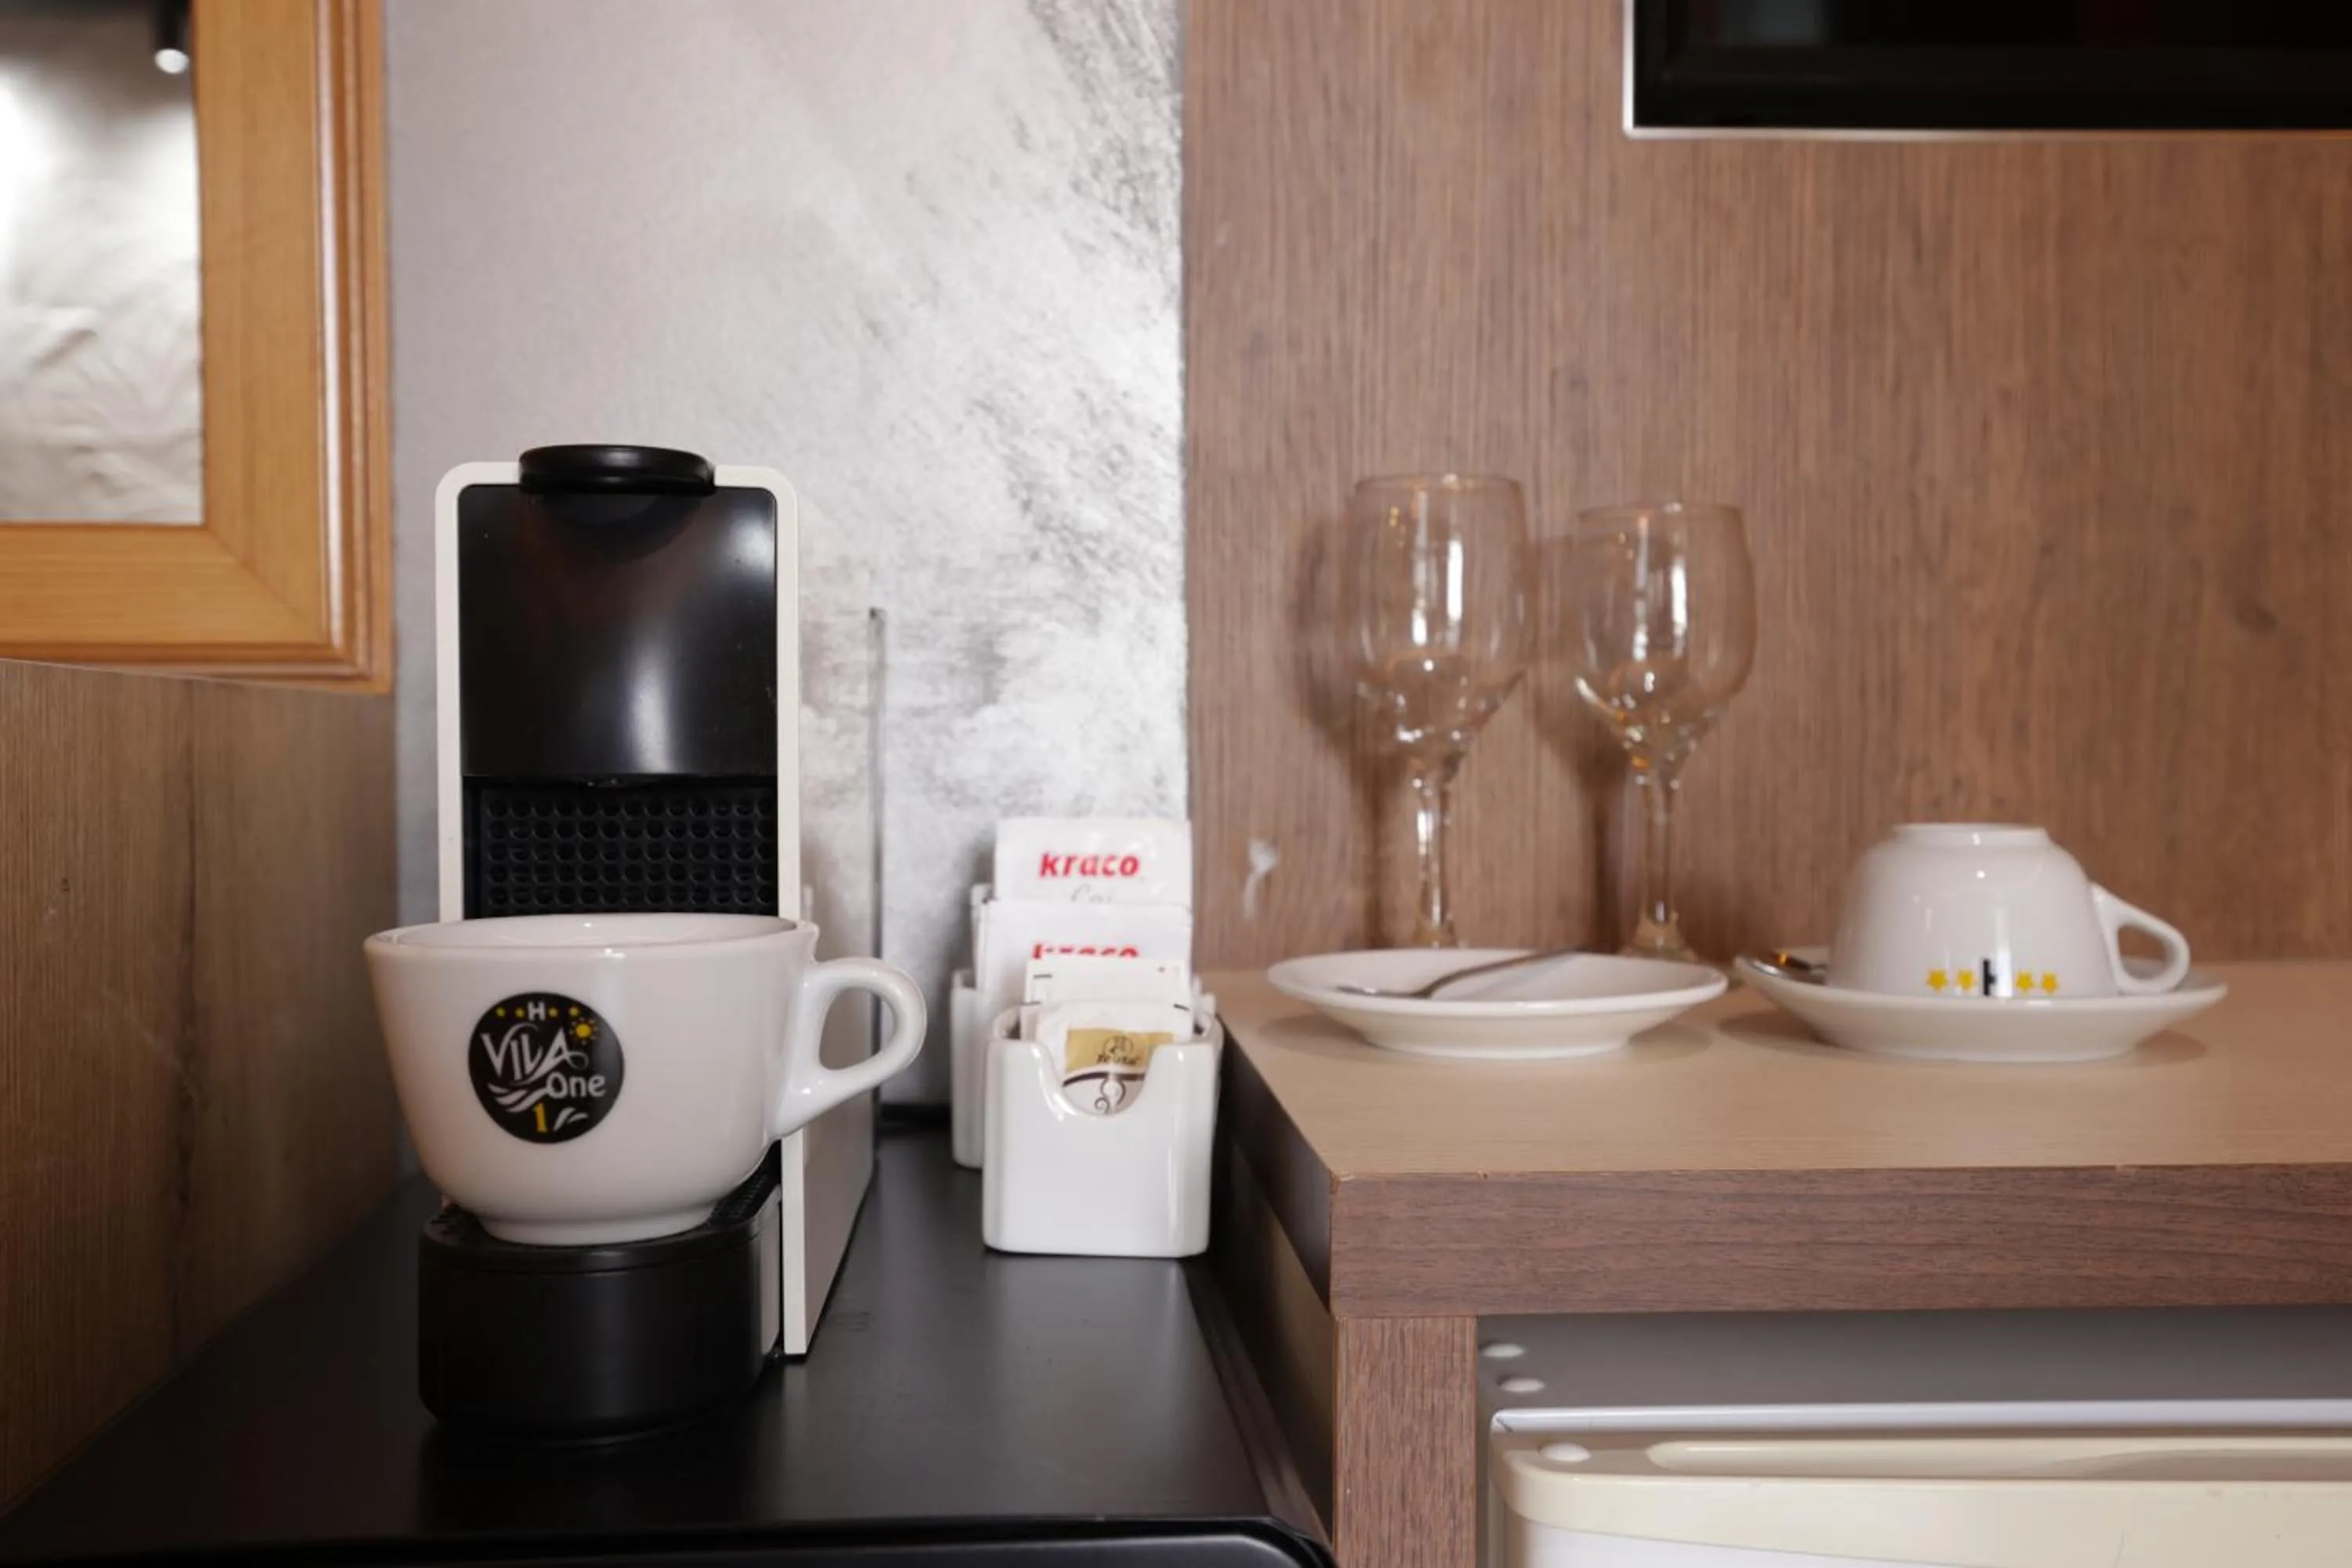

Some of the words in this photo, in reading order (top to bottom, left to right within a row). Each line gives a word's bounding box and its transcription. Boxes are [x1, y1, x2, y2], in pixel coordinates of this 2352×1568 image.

[1039, 851, 1141, 879] kraco
[527, 1001, 547, 1022] H
[546, 1072, 607, 1099] One
[533, 1102, 548, 1133] 1
